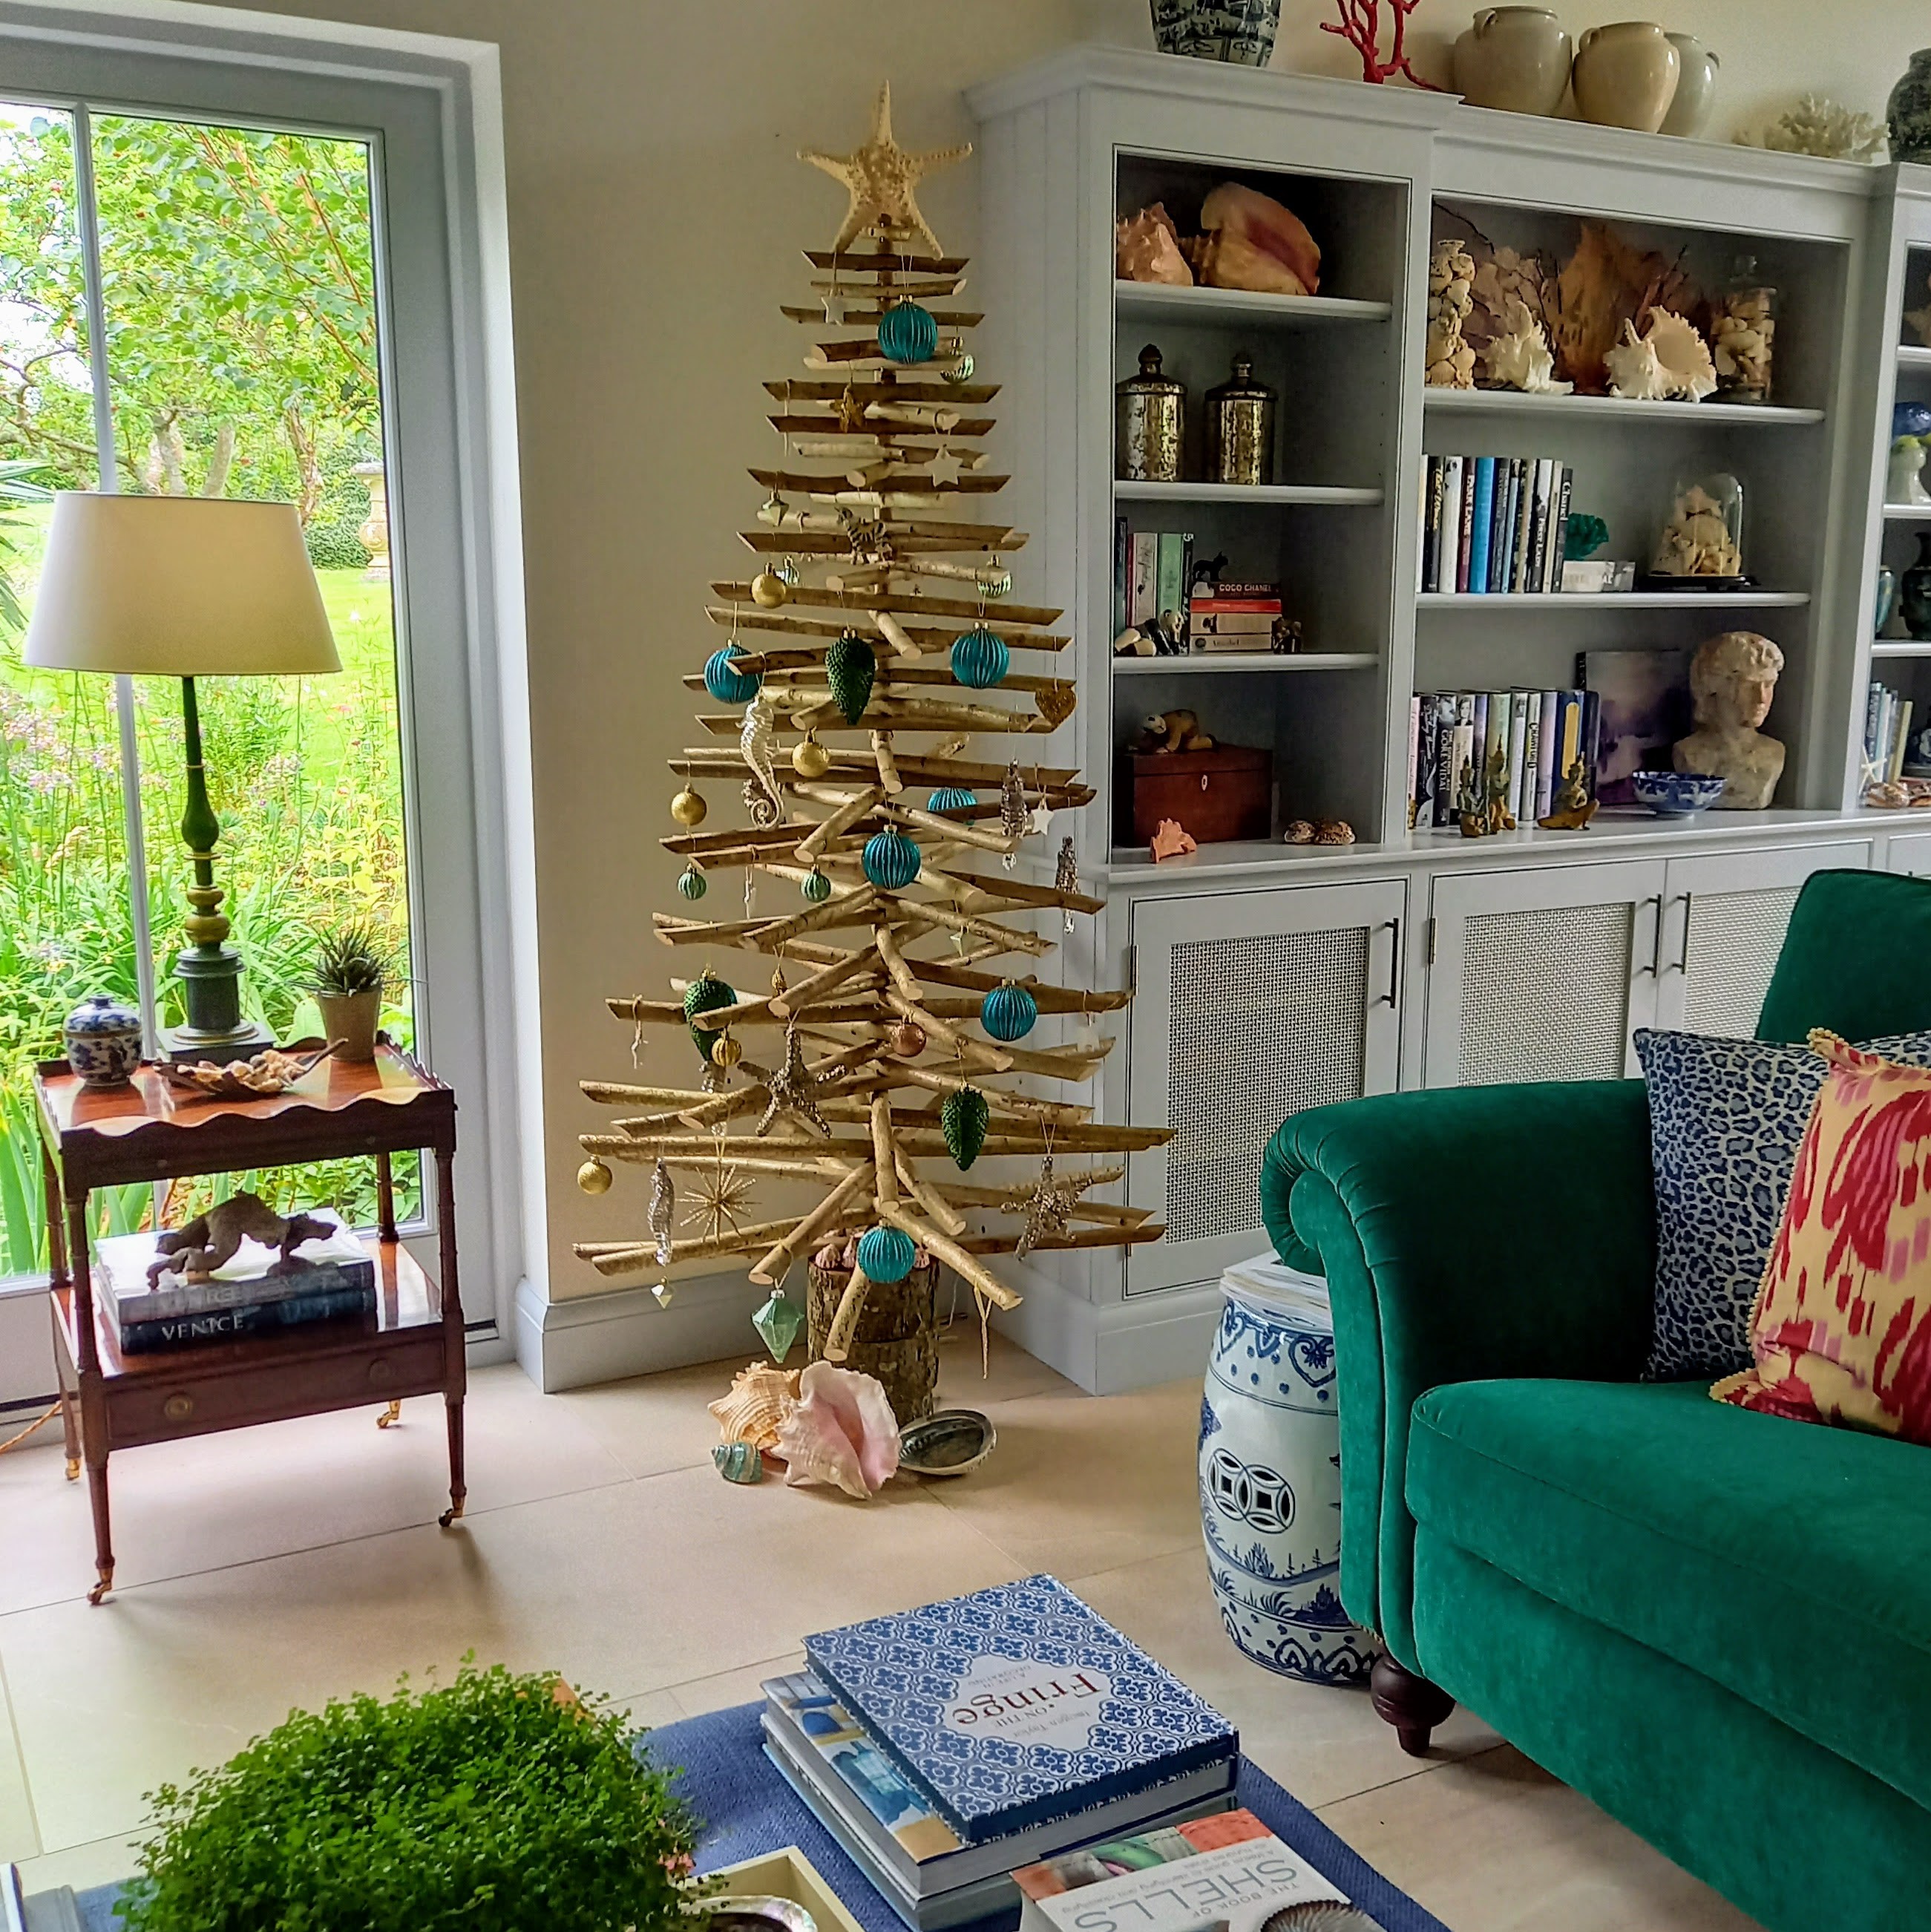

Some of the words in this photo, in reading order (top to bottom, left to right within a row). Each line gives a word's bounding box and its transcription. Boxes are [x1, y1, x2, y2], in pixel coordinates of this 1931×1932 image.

[1560, 482, 1570, 522] Chanel
[1219, 583, 1242, 592] COCO
[1244, 583, 1271, 592] CHANEL
[1440, 729, 1449, 759] GORE
[1439, 760, 1448, 792] VIDAL
[161, 1314, 244, 1341] VENICE
[952, 1673, 1102, 1725] Fringe
[991, 1713, 1023, 1729] THE
[1023, 1706, 1048, 1719] ON
[1012, 1723, 1046, 1738] Taylor
[1075, 1859, 1297, 1932] SHELLS
[1269, 1882, 1299, 1895] THE
[1216, 1892, 1263, 1910] BOOK
[1191, 1907, 1213, 1918] OF
